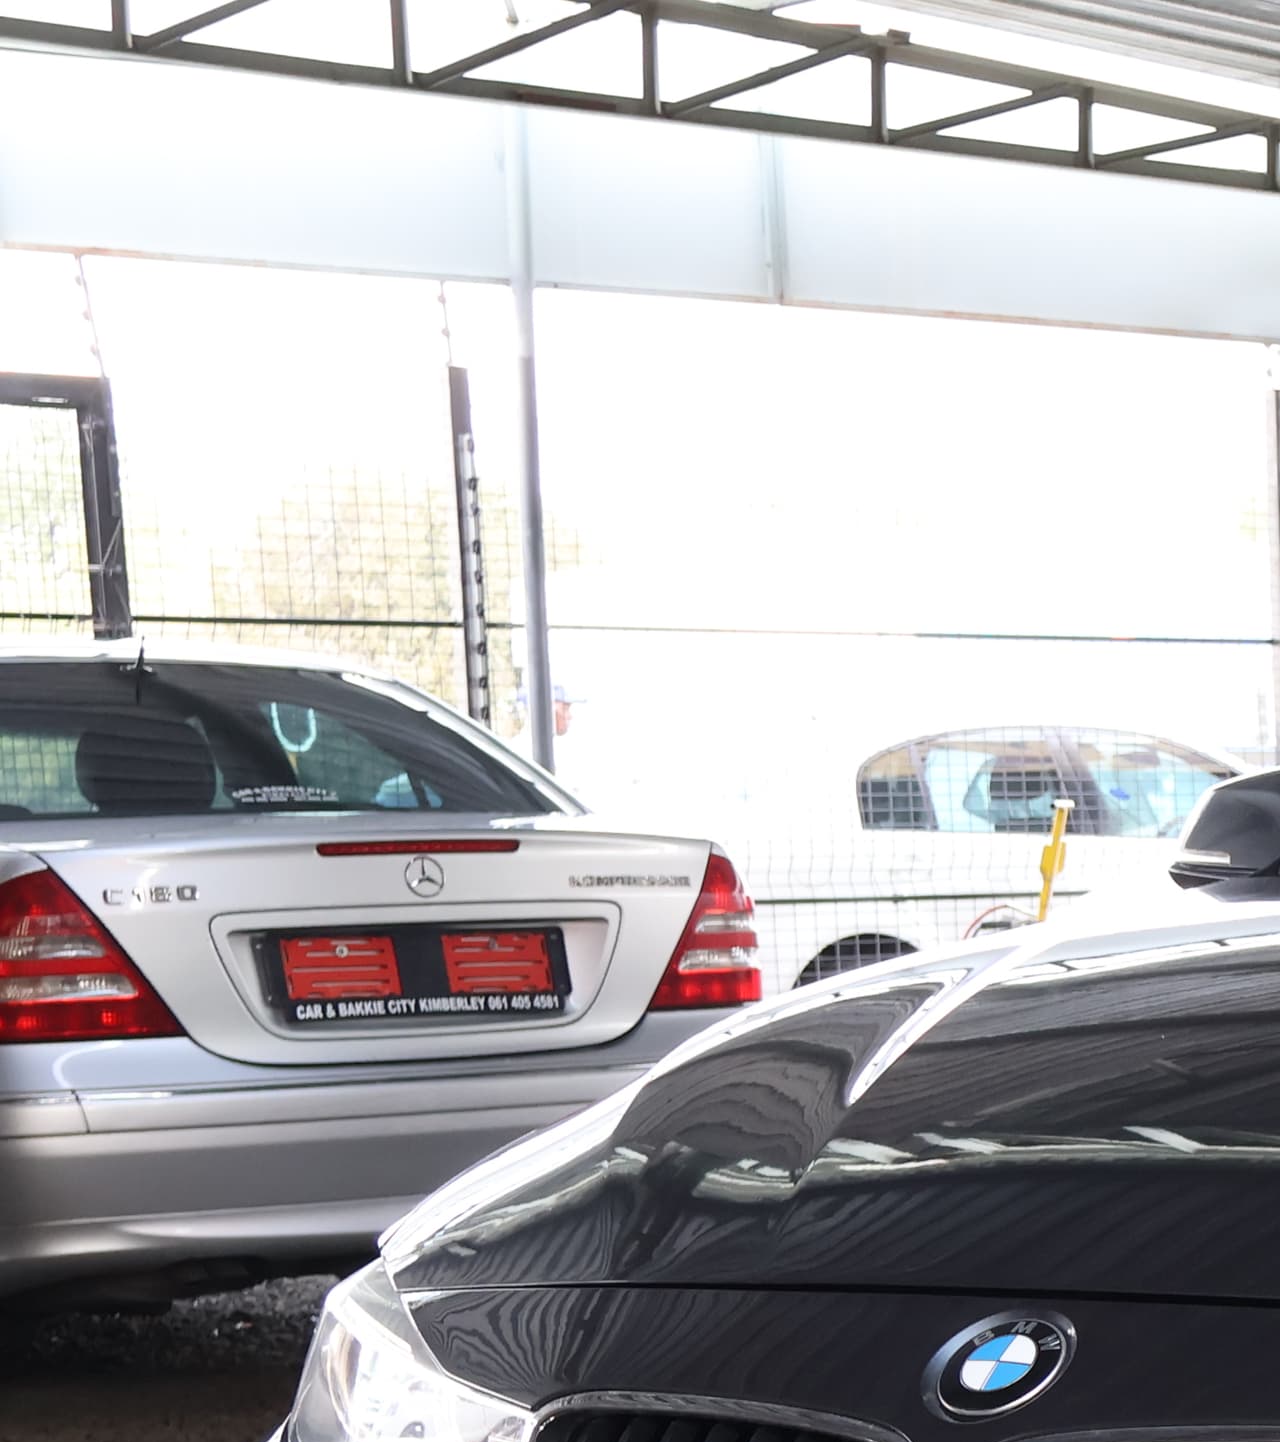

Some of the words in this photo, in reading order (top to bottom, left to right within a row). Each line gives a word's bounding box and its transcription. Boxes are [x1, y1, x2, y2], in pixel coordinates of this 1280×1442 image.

[296, 1004, 323, 1020] CAR
[326, 1002, 336, 1019] &
[338, 1000, 386, 1017] BAKKIE
[387, 998, 416, 1014] CITY
[419, 995, 485, 1012] KIMBERLEY
[487, 994, 508, 1011] 061
[511, 994, 531, 1010] 405
[533, 994, 559, 1009] 4581
[972, 1321, 1061, 1352] BMW
